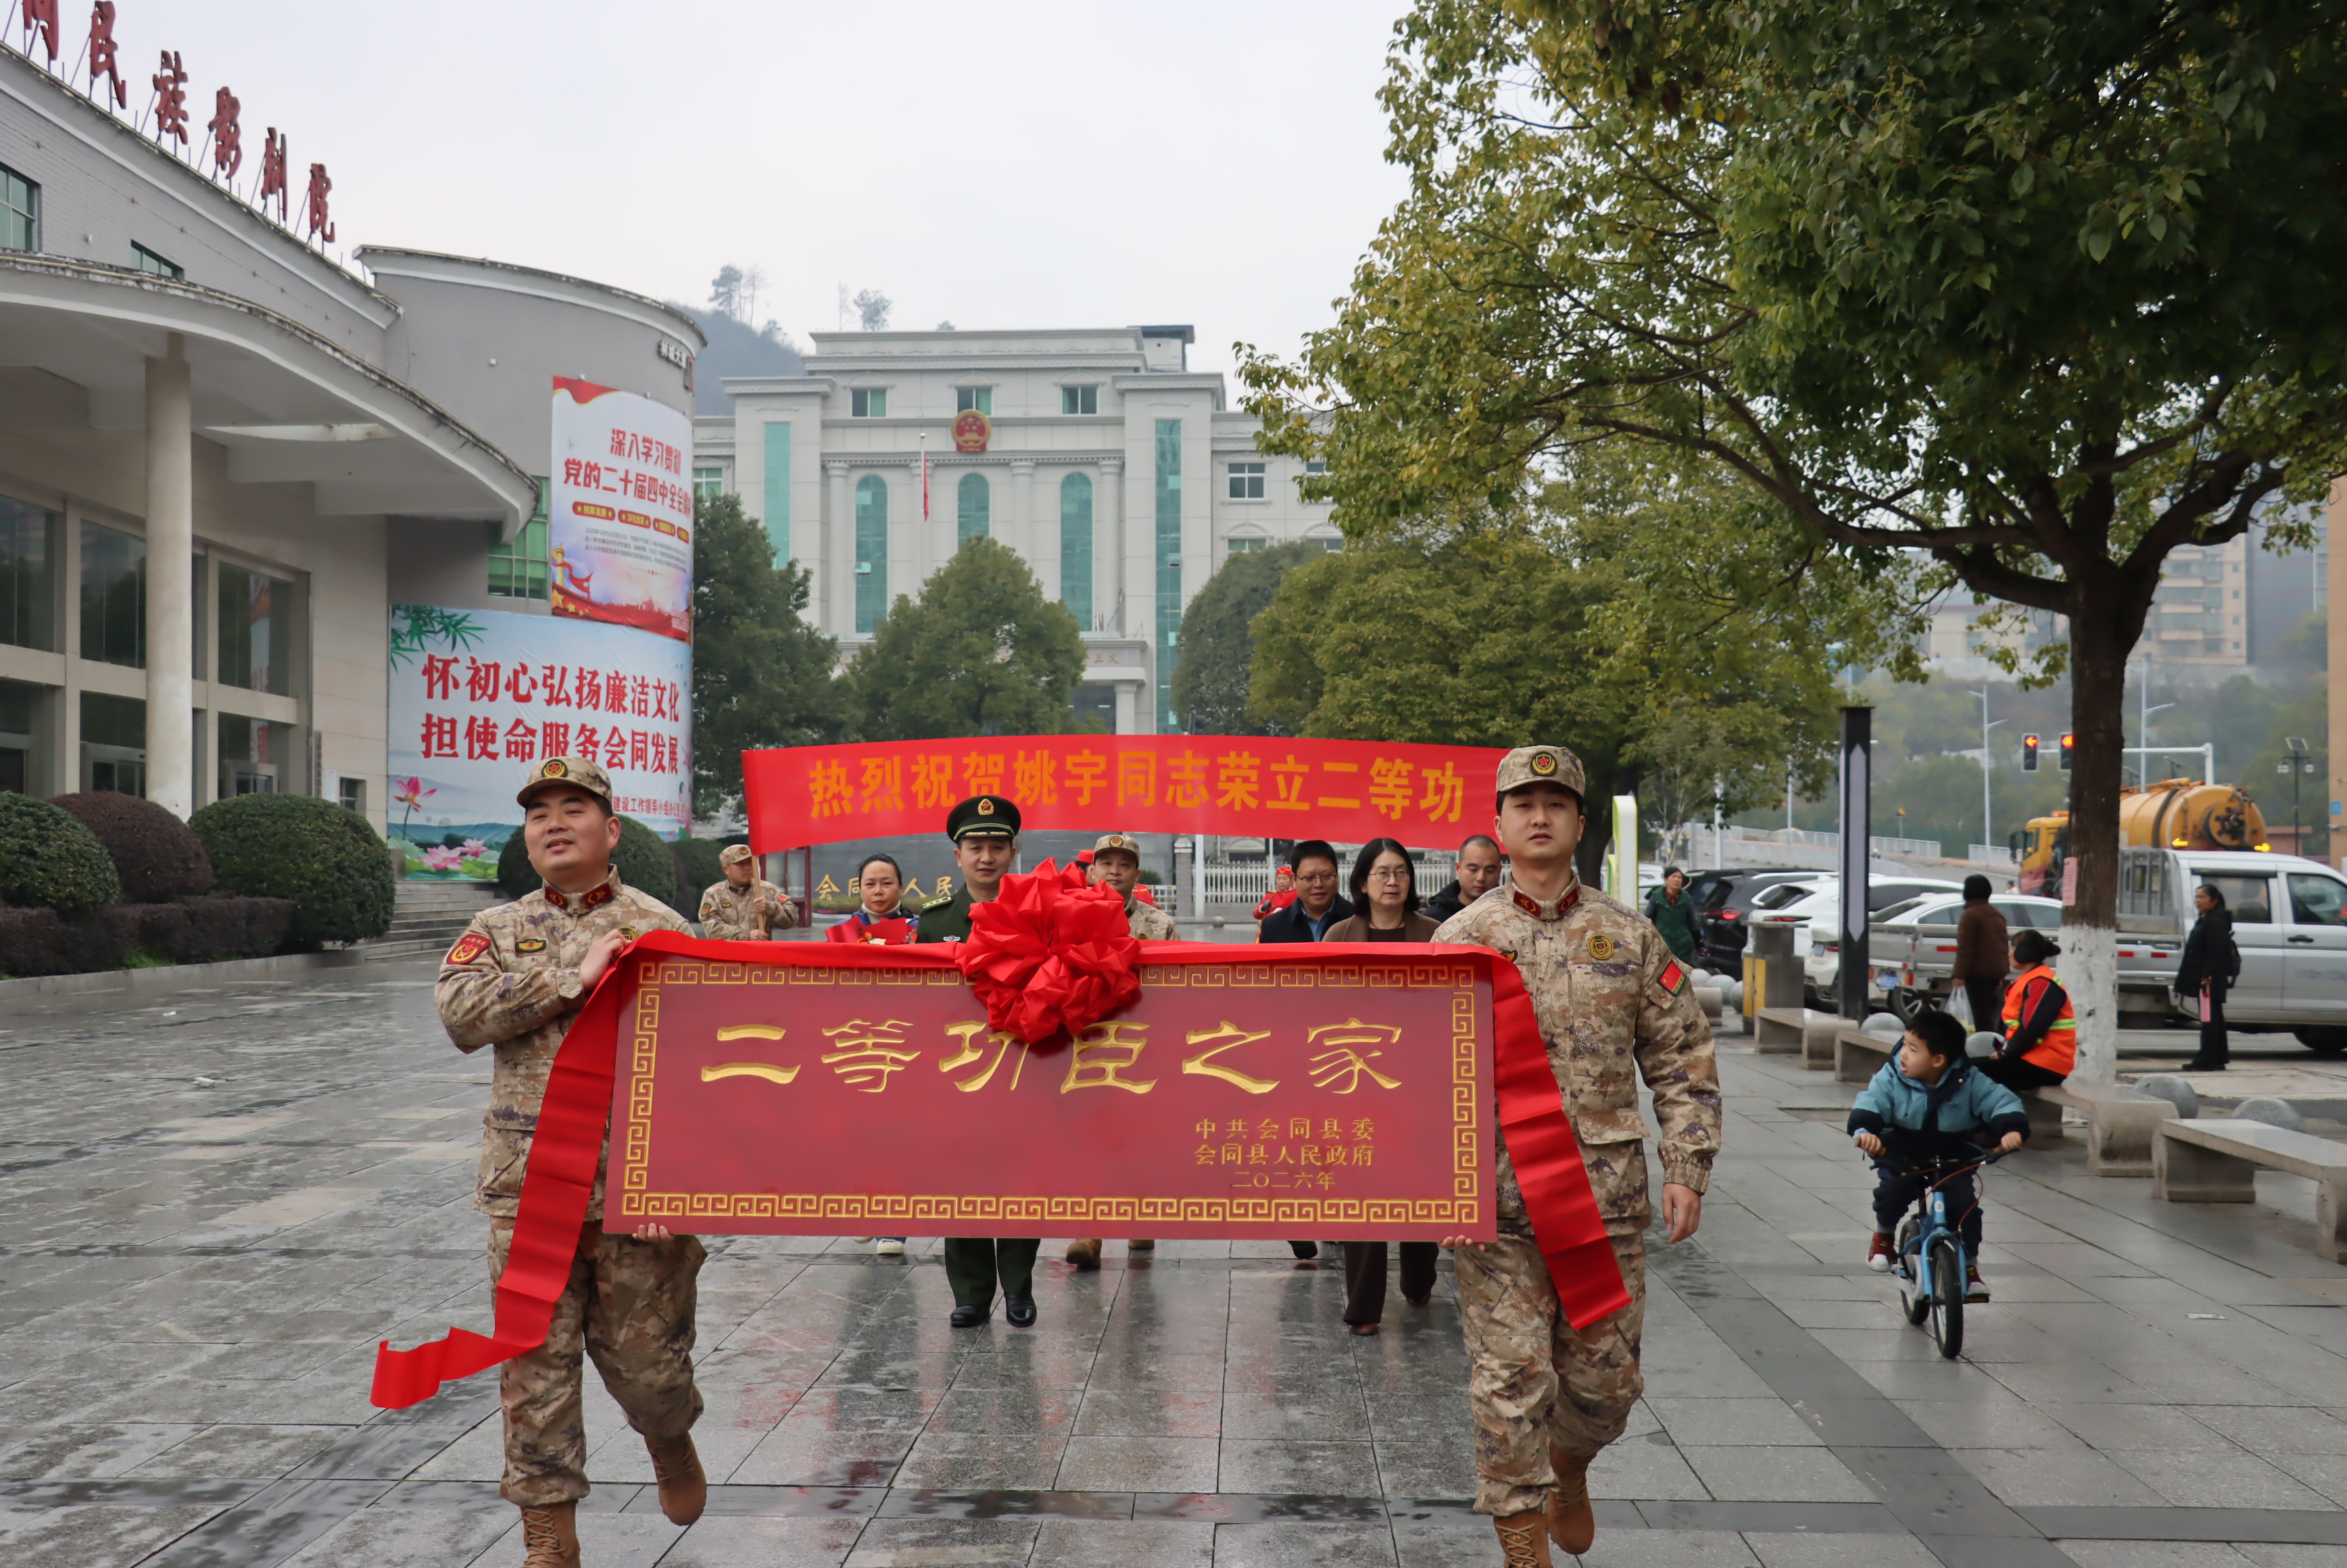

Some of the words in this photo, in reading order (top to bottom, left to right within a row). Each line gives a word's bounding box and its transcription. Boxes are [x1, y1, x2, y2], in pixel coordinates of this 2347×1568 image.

[421, 653, 679, 722] 怀初心弘扬廉洁文化
[420, 712, 679, 776] 担使命服务会同发展
[808, 749, 1464, 823] 热烈祝贺姚宇同志荣立二等功
[700, 1017, 1403, 1095] 二等功臣之家
[1194, 1143, 1375, 1167] 会同县人民政府
[1195, 1117, 1375, 1140] 中共会同县委
